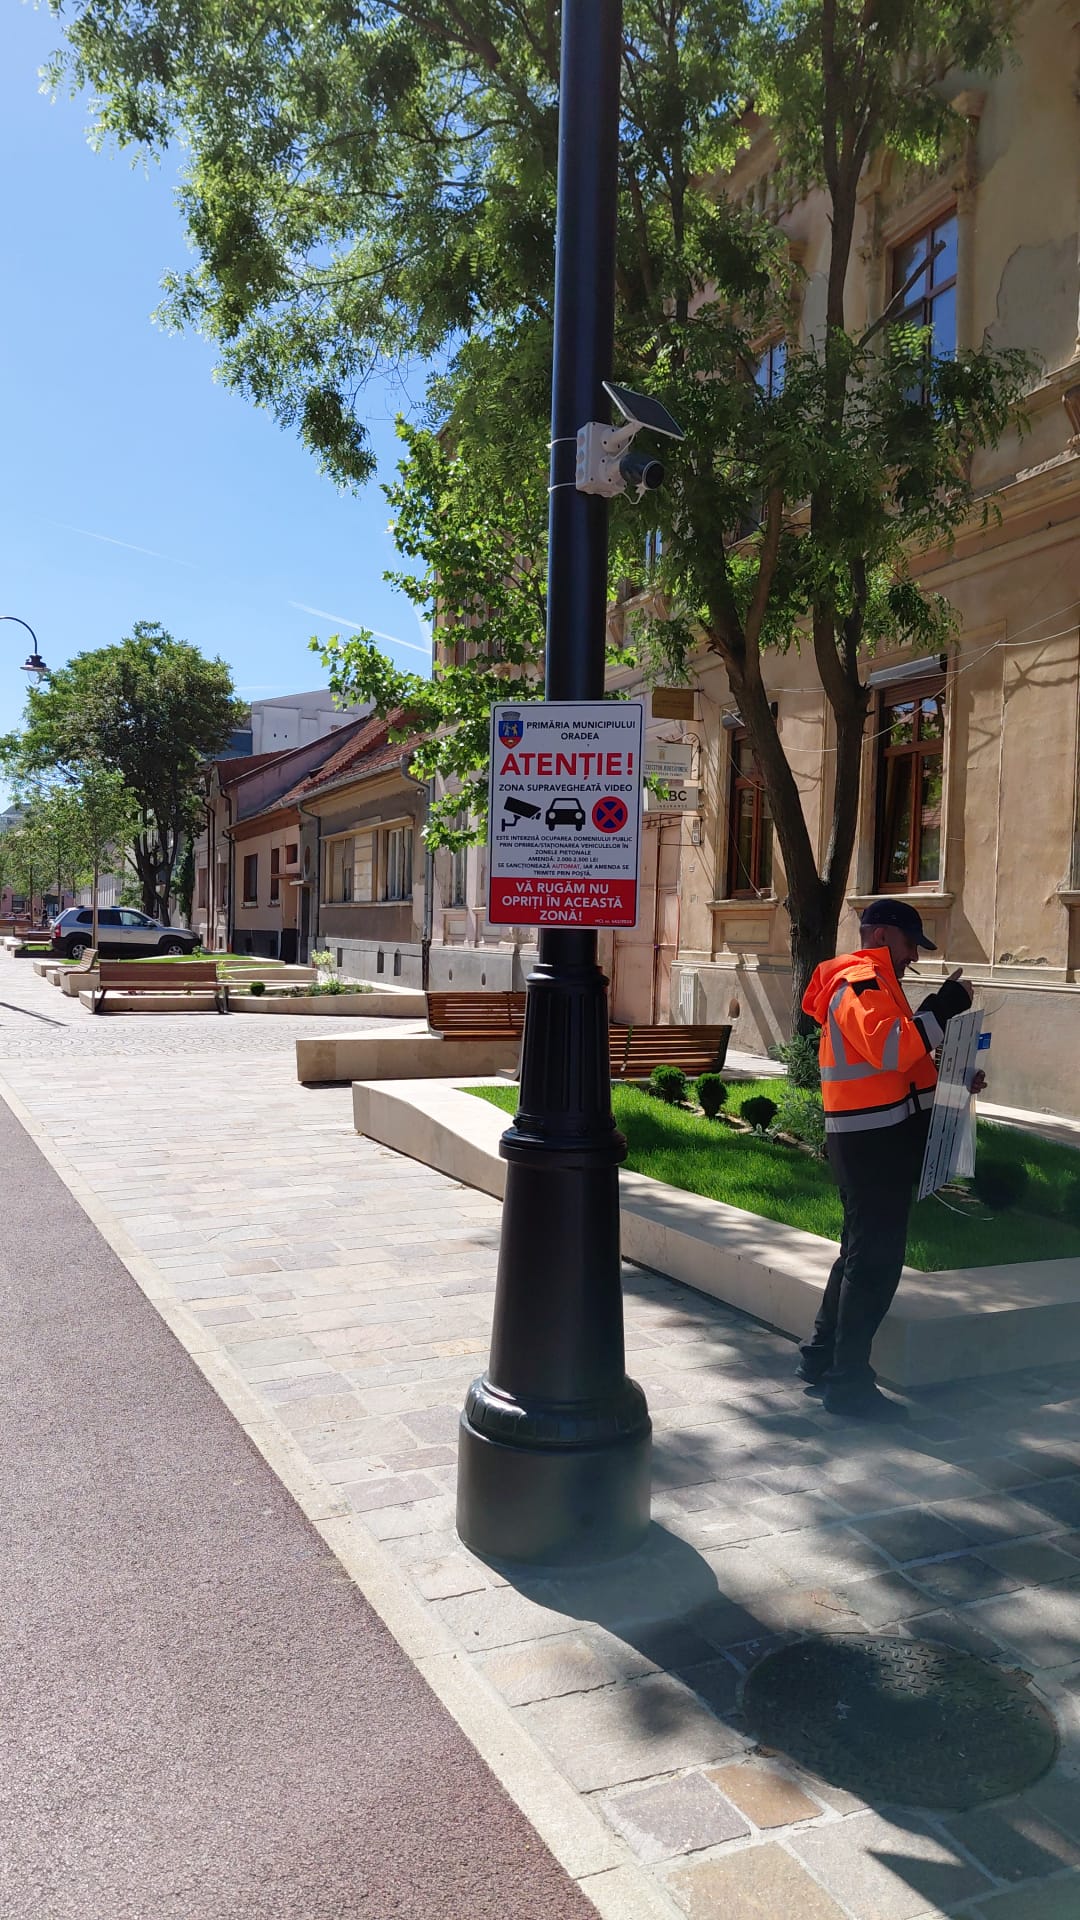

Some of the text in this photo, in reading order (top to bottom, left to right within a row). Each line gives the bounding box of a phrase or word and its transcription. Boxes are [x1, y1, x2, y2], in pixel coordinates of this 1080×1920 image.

[526, 720, 636, 729] PRIMĂRIA MUNICIPIULUI
[560, 732, 600, 740] ORADEA
[500, 752, 633, 780] ATENȚIE!
[498, 782, 633, 792] ZONA SUPRAVEGHEATĂ VIDEO
[515, 881, 609, 894] VĂ RUGĂM NU
[501, 894, 623, 909] OPRIȚI ÎN ACEASTĂ
[539, 909, 583, 921] ZONĂ!
